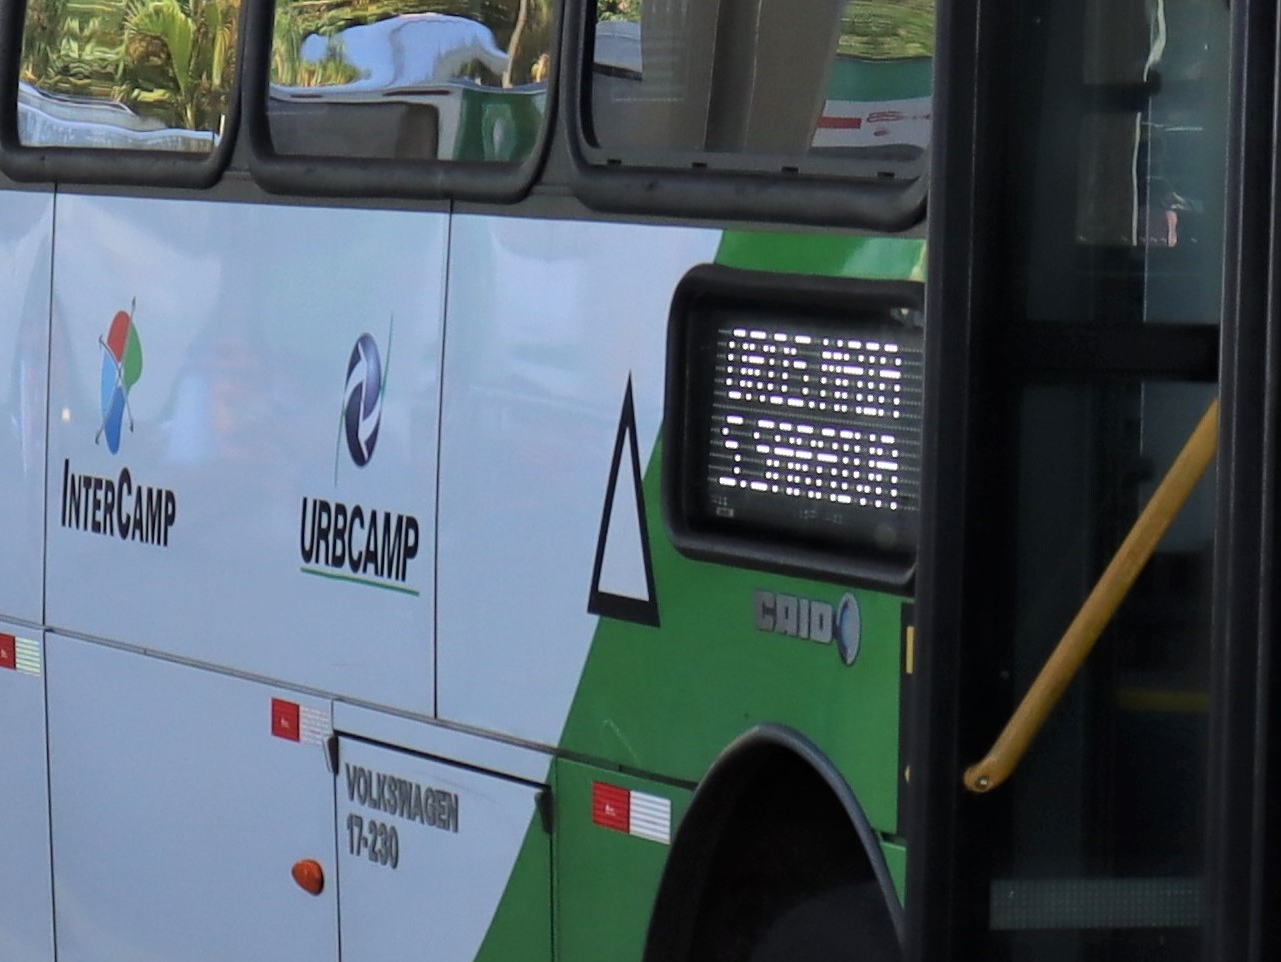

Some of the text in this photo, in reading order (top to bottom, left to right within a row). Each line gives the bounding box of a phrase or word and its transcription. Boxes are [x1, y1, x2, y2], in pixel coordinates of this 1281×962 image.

[300, 496, 419, 582] URBCAMP
[755, 590, 833, 645] CAIO
[345, 762, 459, 834] VOLKSWAGEN
[346, 812, 399, 870] 17-230
